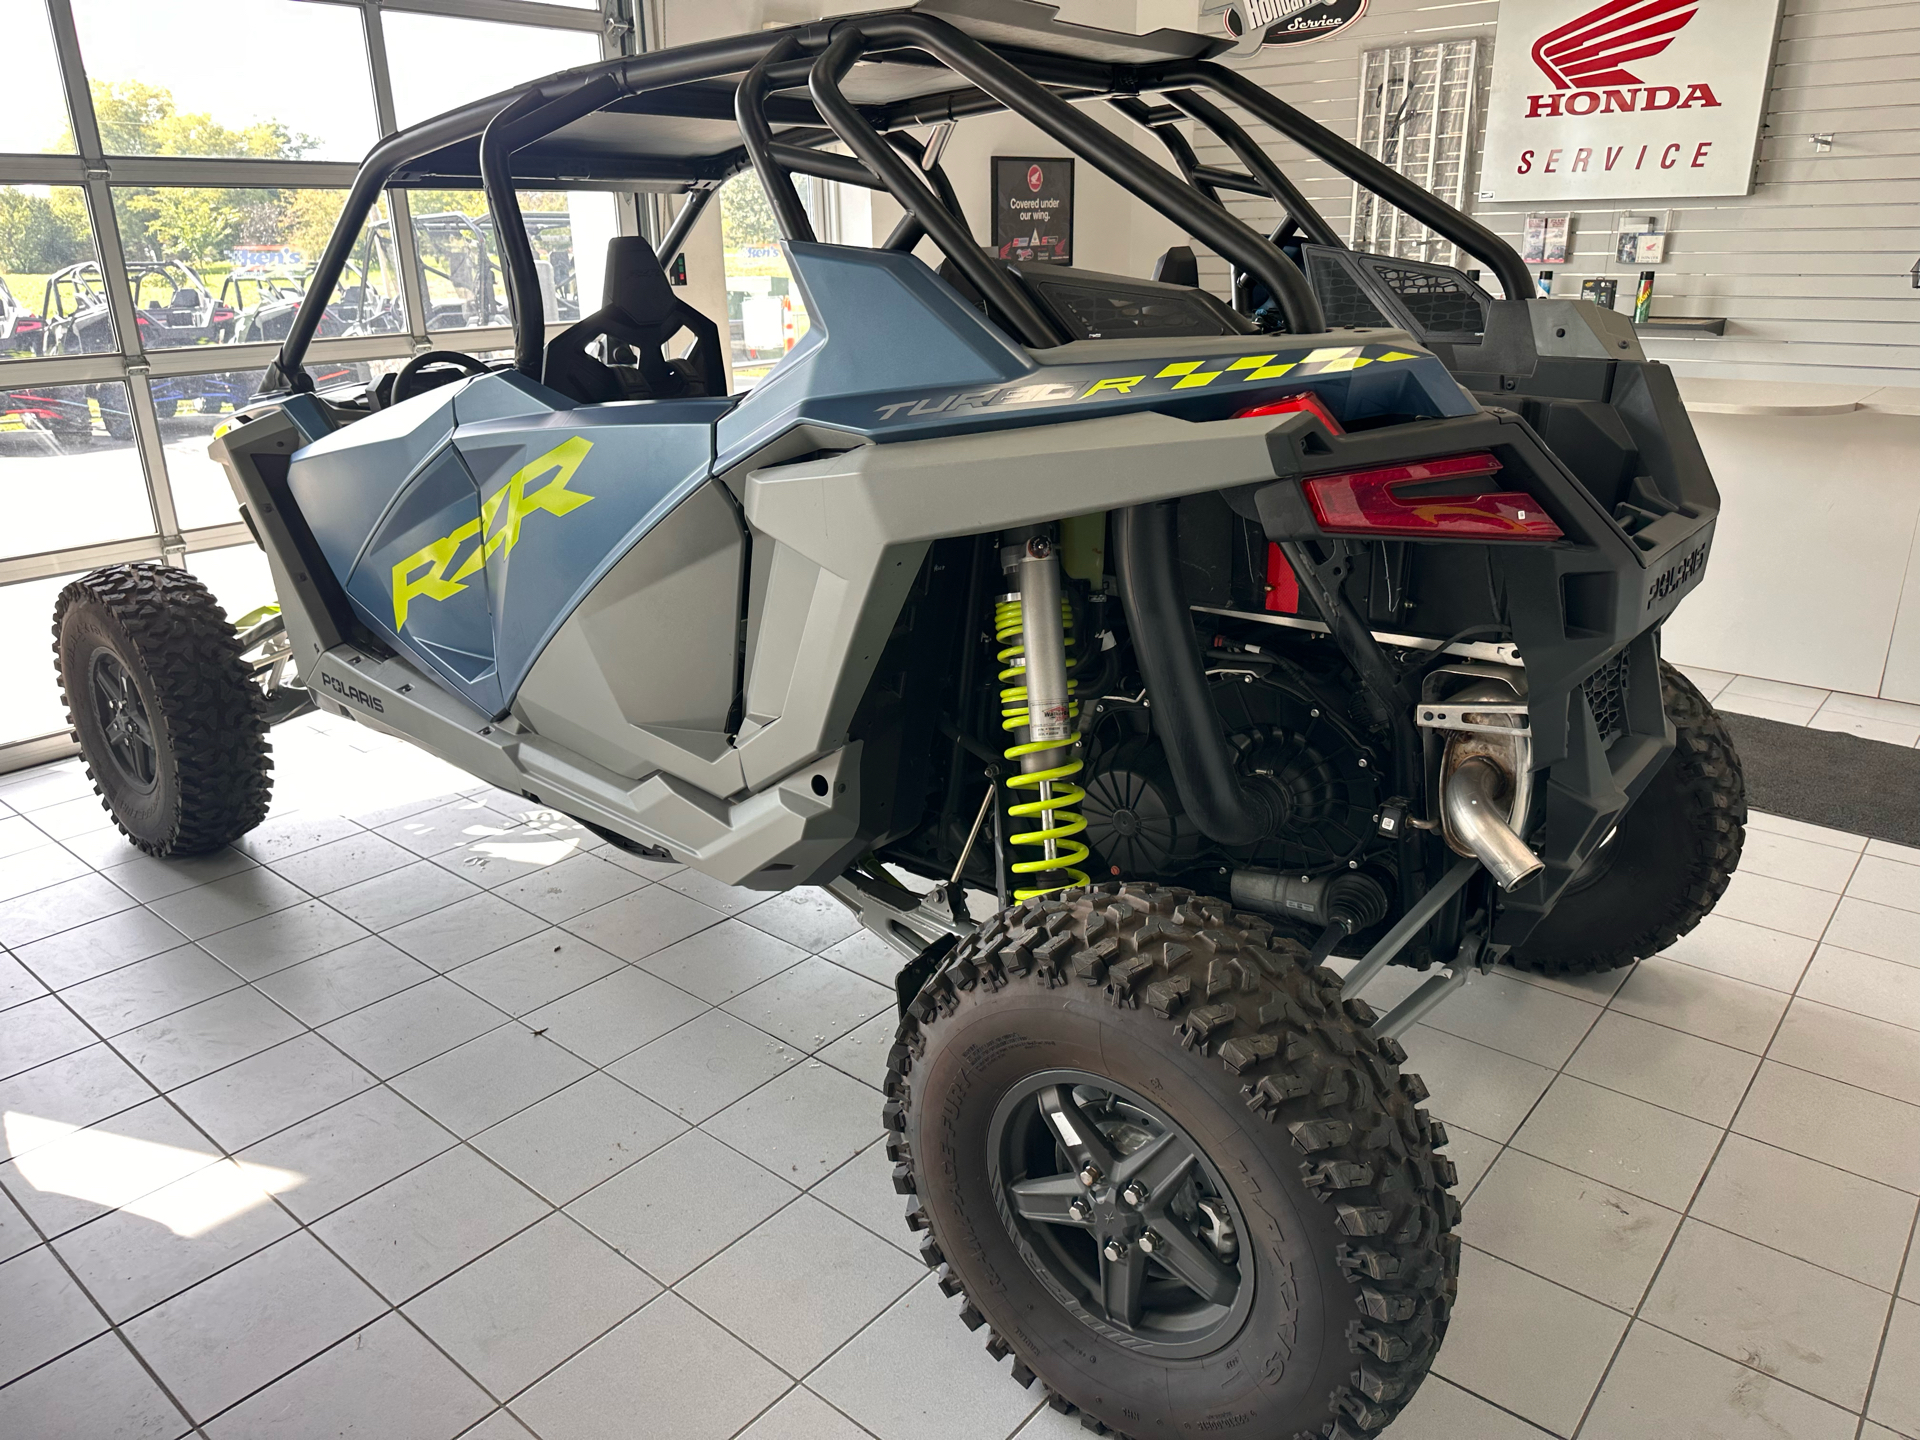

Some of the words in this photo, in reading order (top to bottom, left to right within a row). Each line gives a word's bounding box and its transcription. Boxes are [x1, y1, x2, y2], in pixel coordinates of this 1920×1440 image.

[1287, 14, 1343, 31] Service
[1524, 83, 1722, 118] HONDA
[1517, 142, 1713, 175] SERVICE
[1010, 198, 1039, 209] Covered
[1040, 198, 1060, 209] under
[1019, 212, 1031, 221] our
[1032, 209, 1051, 222] wing.
[240, 247, 301, 267] ken's
[873, 380, 1089, 421] TURBO
[1076, 375, 1147, 401] R
[391, 435, 596, 634] RZR
[1646, 542, 1706, 611] POLARIS
[321, 671, 384, 713] POLARIS
